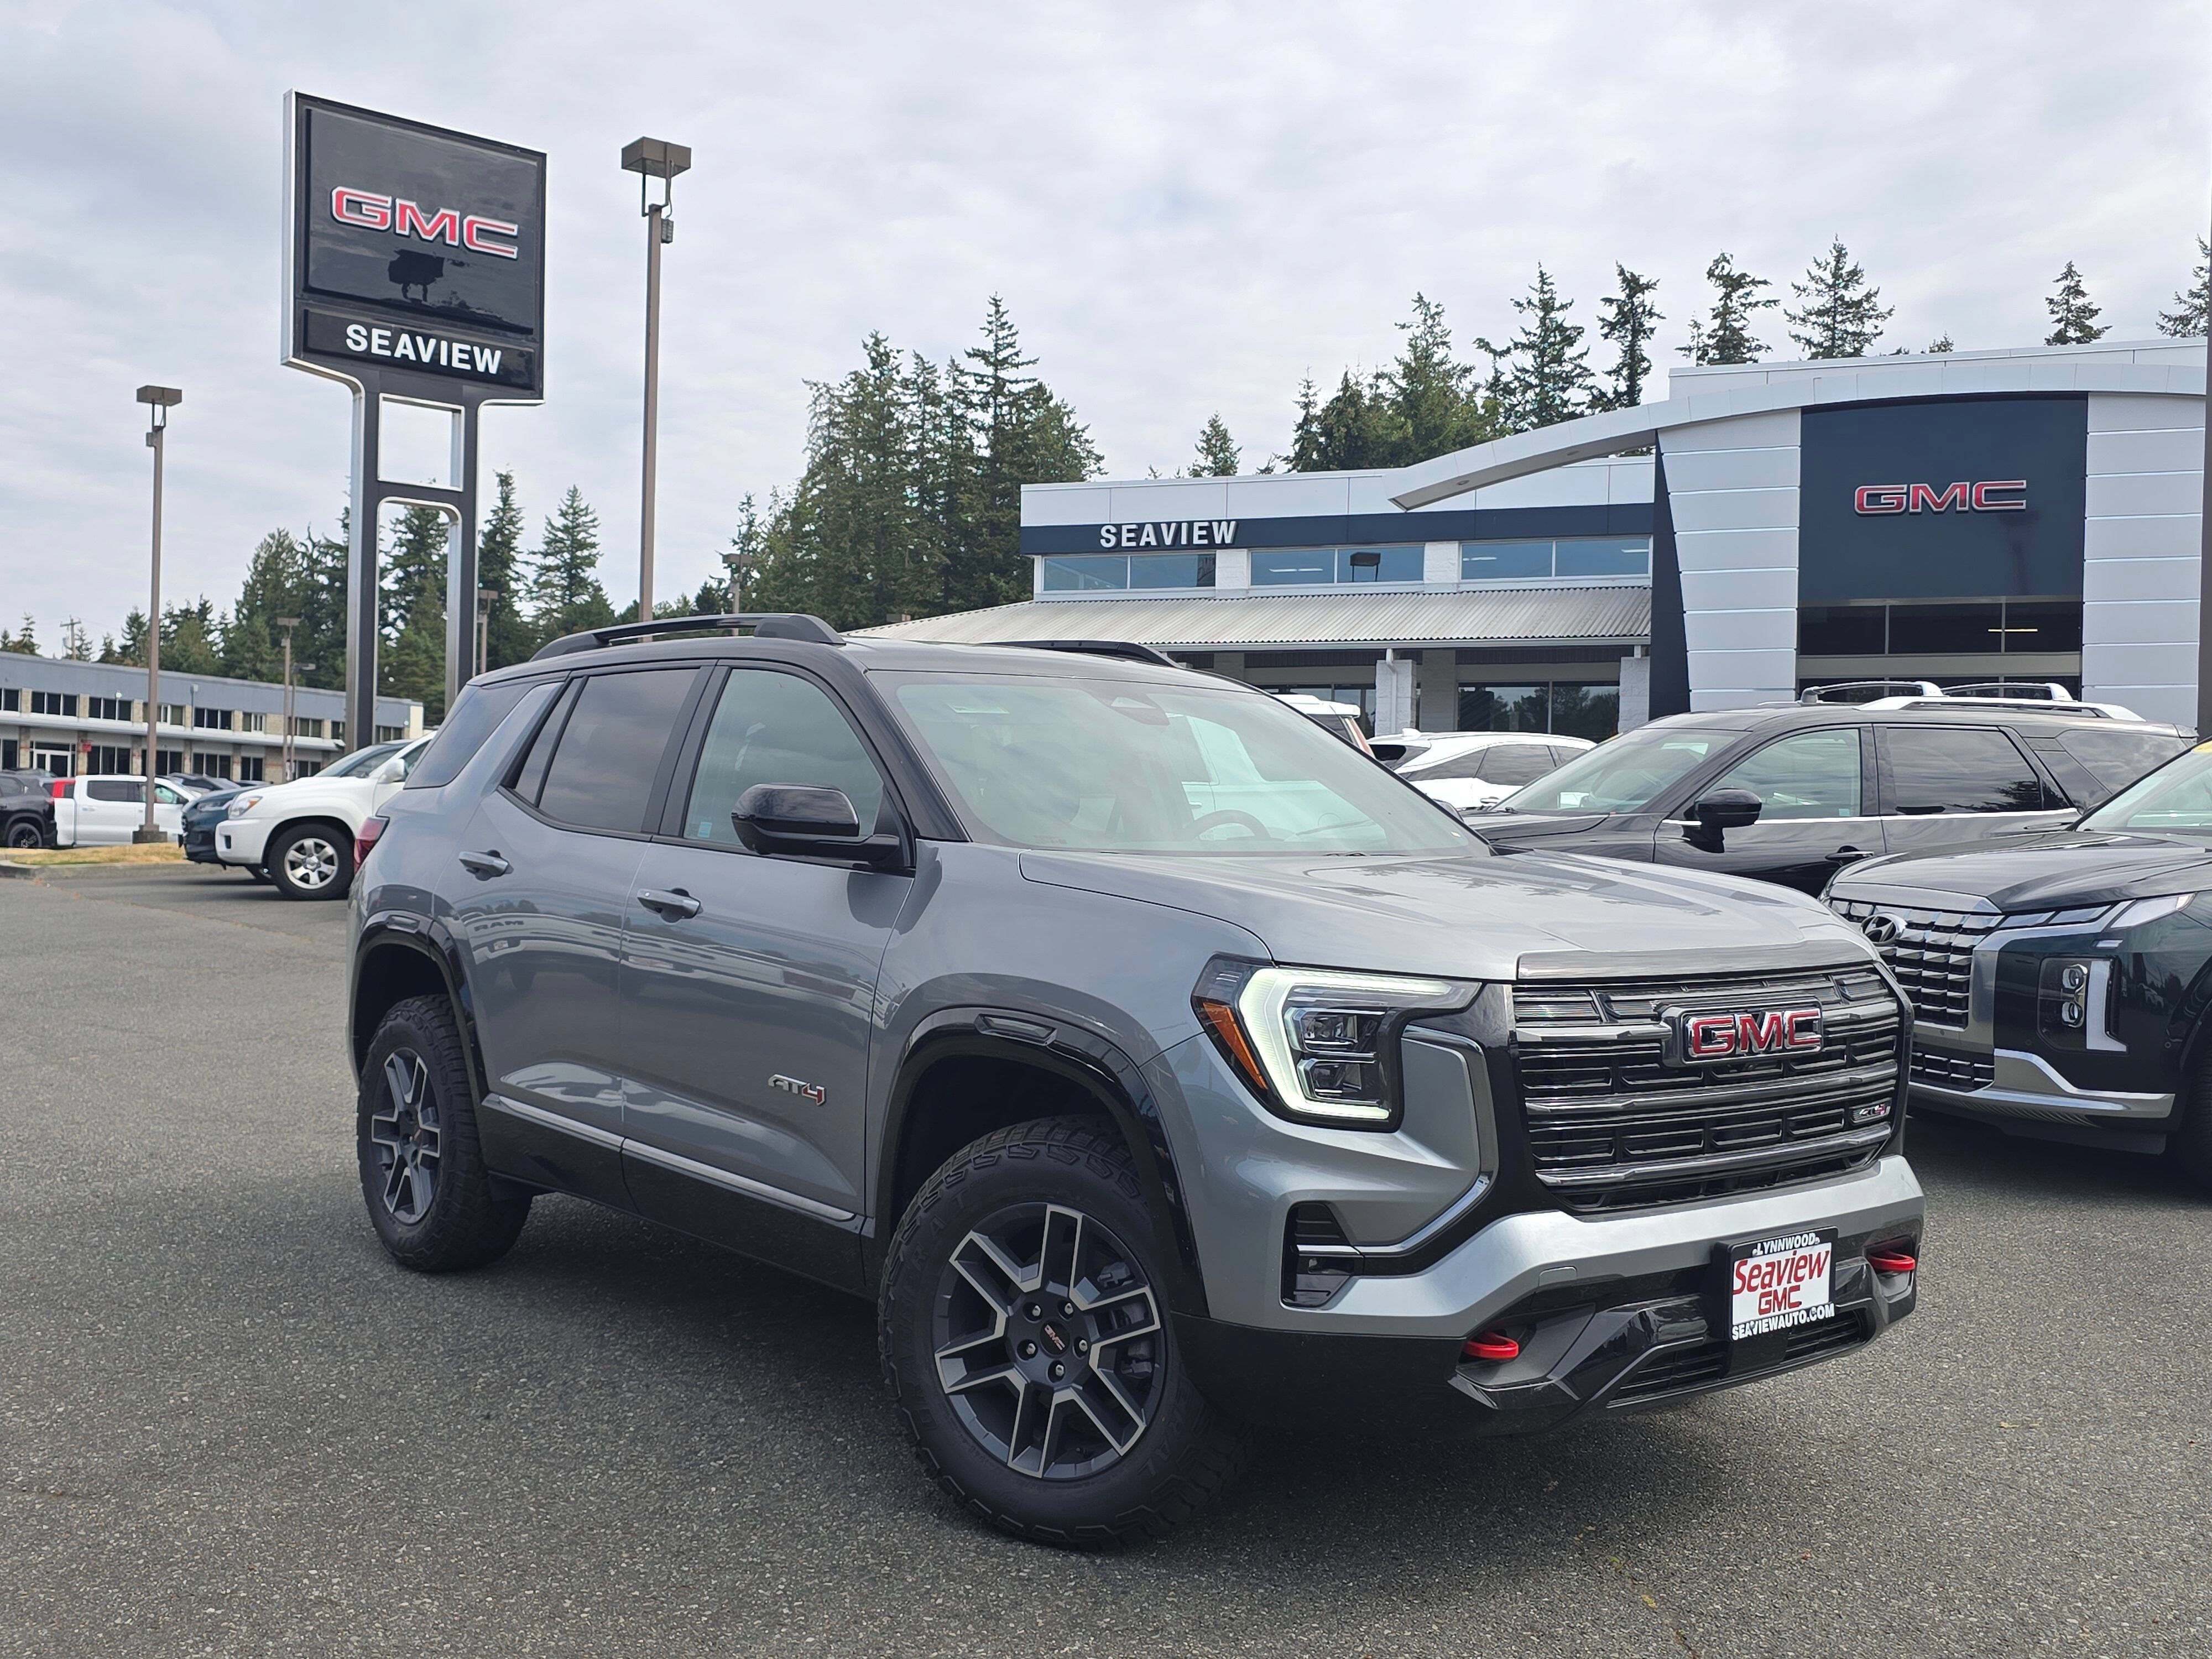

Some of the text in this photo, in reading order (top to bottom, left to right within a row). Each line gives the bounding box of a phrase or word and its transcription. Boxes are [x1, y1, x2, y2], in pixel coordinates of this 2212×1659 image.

[332, 186, 518, 259] GMC
[346, 324, 502, 374] SEAVIEW
[1854, 479, 2027, 514] GMC
[1099, 521, 1237, 548] SEAVIEW
[1686, 1008, 1822, 1058] GMC
[1755, 1232, 1817, 1256] LYNNWOOD
[1731, 1250, 1830, 1296] Seaview
[1757, 1284, 1802, 1316] GMC
[1731, 1303, 1835, 1341] SEAVIEWAUTO.COM
